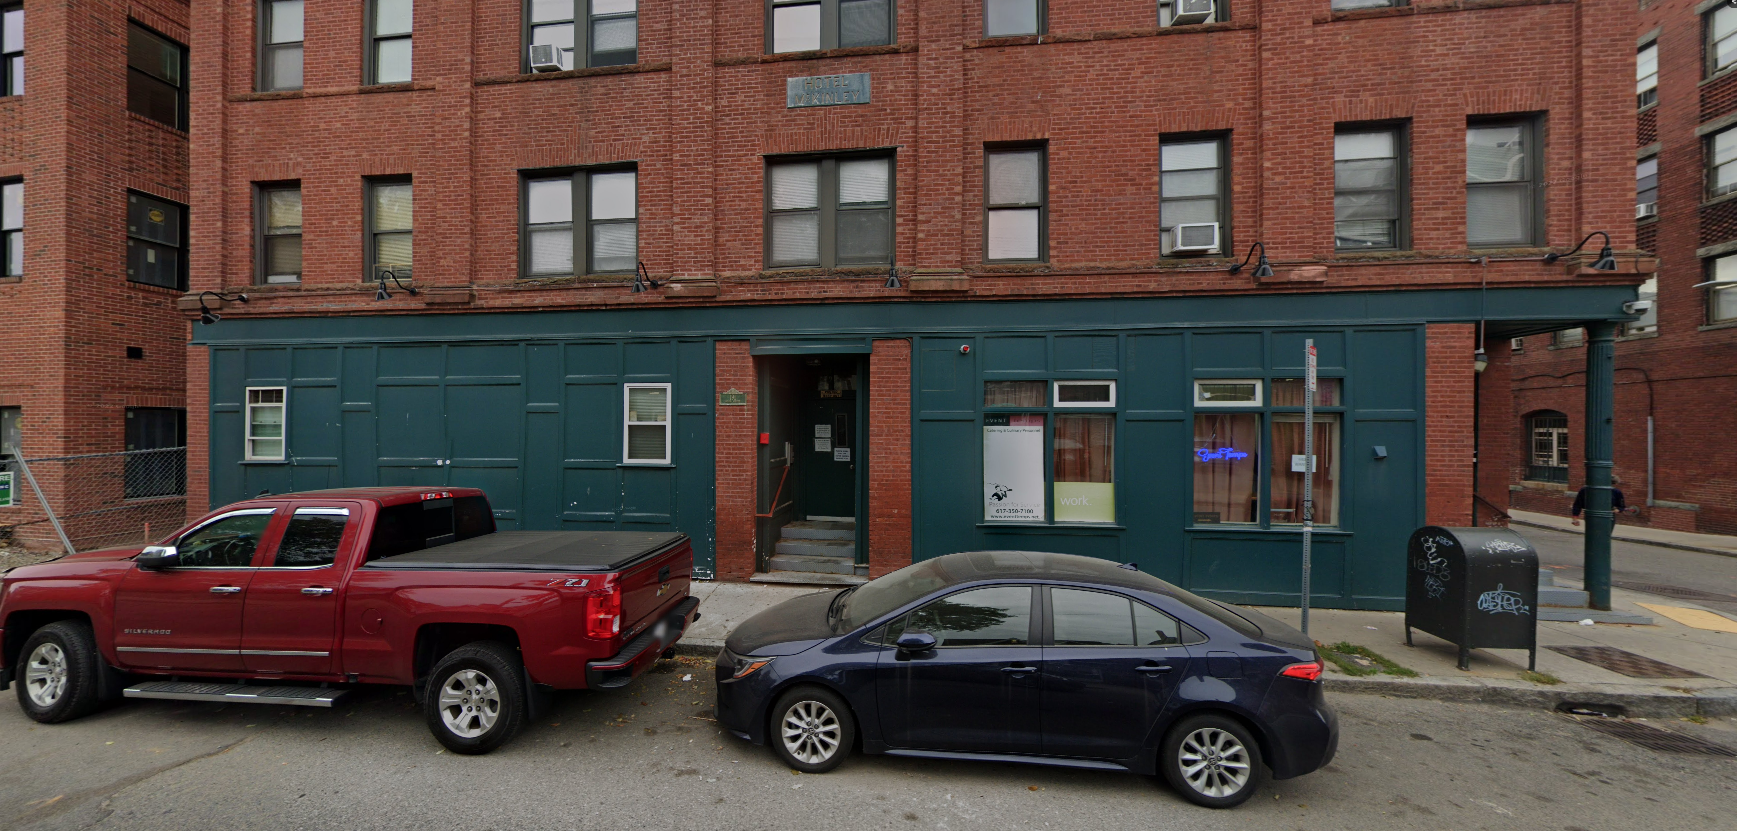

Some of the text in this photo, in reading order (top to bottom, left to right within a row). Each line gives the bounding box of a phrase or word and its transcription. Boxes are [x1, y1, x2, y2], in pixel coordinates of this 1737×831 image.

[805, 76, 848, 89] HOTEL
[1060, 494, 1093, 506] work.
[546, 577, 591, 588] Z71
